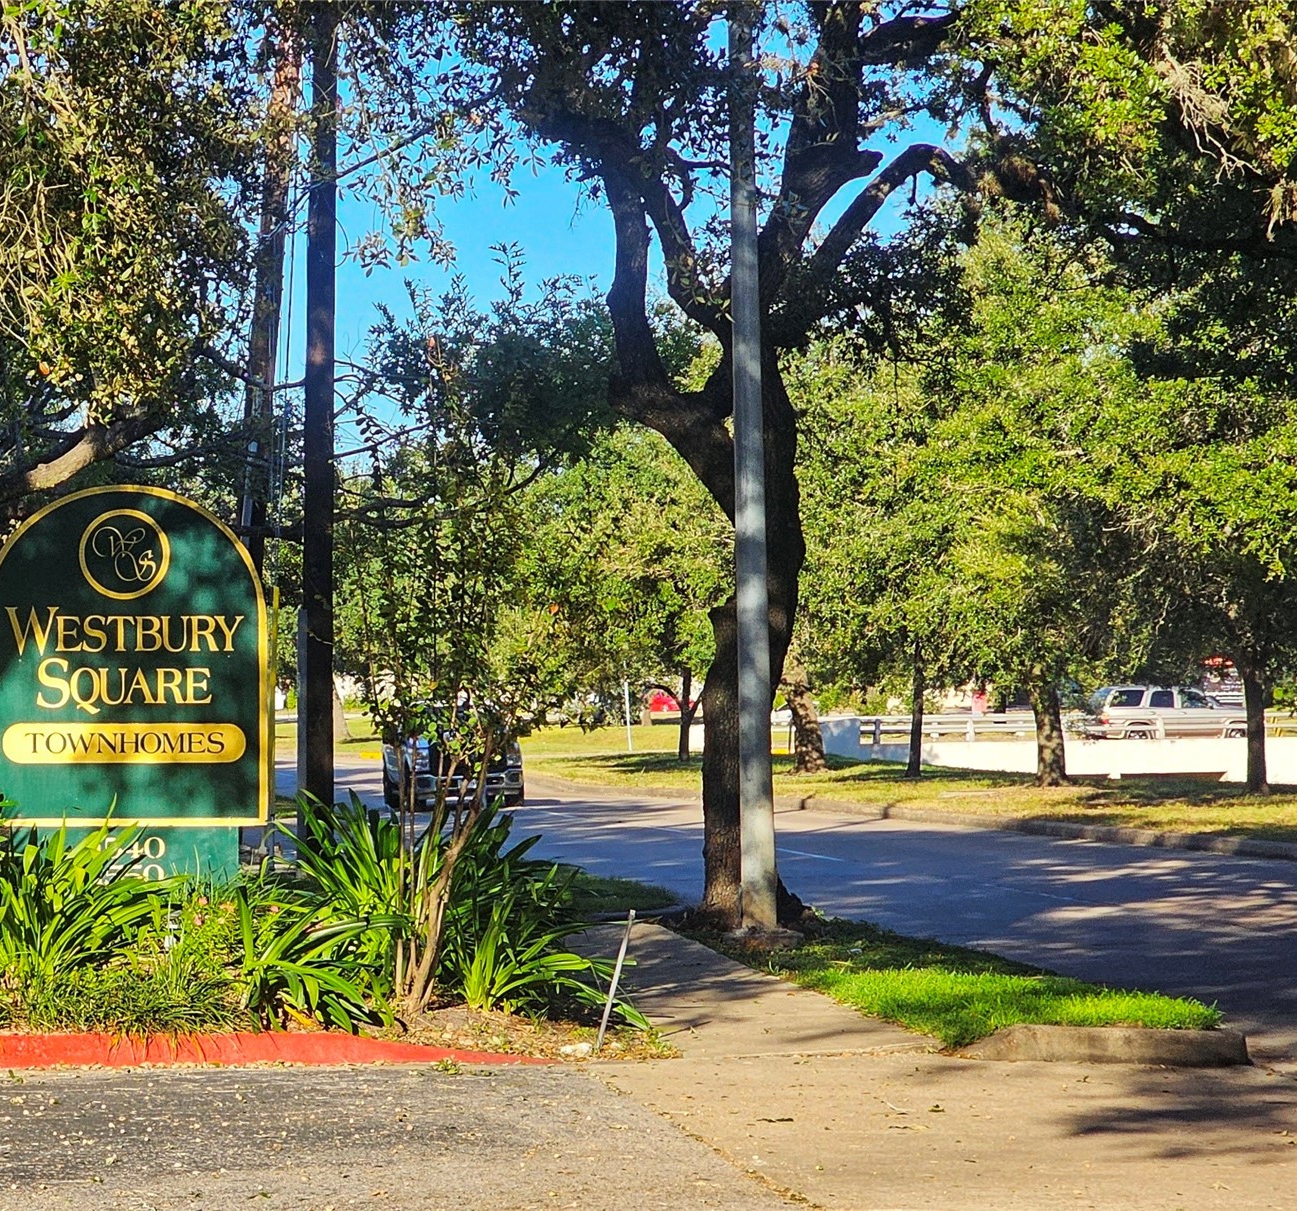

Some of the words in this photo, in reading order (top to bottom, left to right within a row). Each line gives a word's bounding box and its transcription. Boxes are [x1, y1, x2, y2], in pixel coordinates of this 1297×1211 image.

[4, 606, 245, 656] WESTBURY
[36, 657, 213, 714] SQUARE
[24, 732, 225, 754] TOWNHOMES
